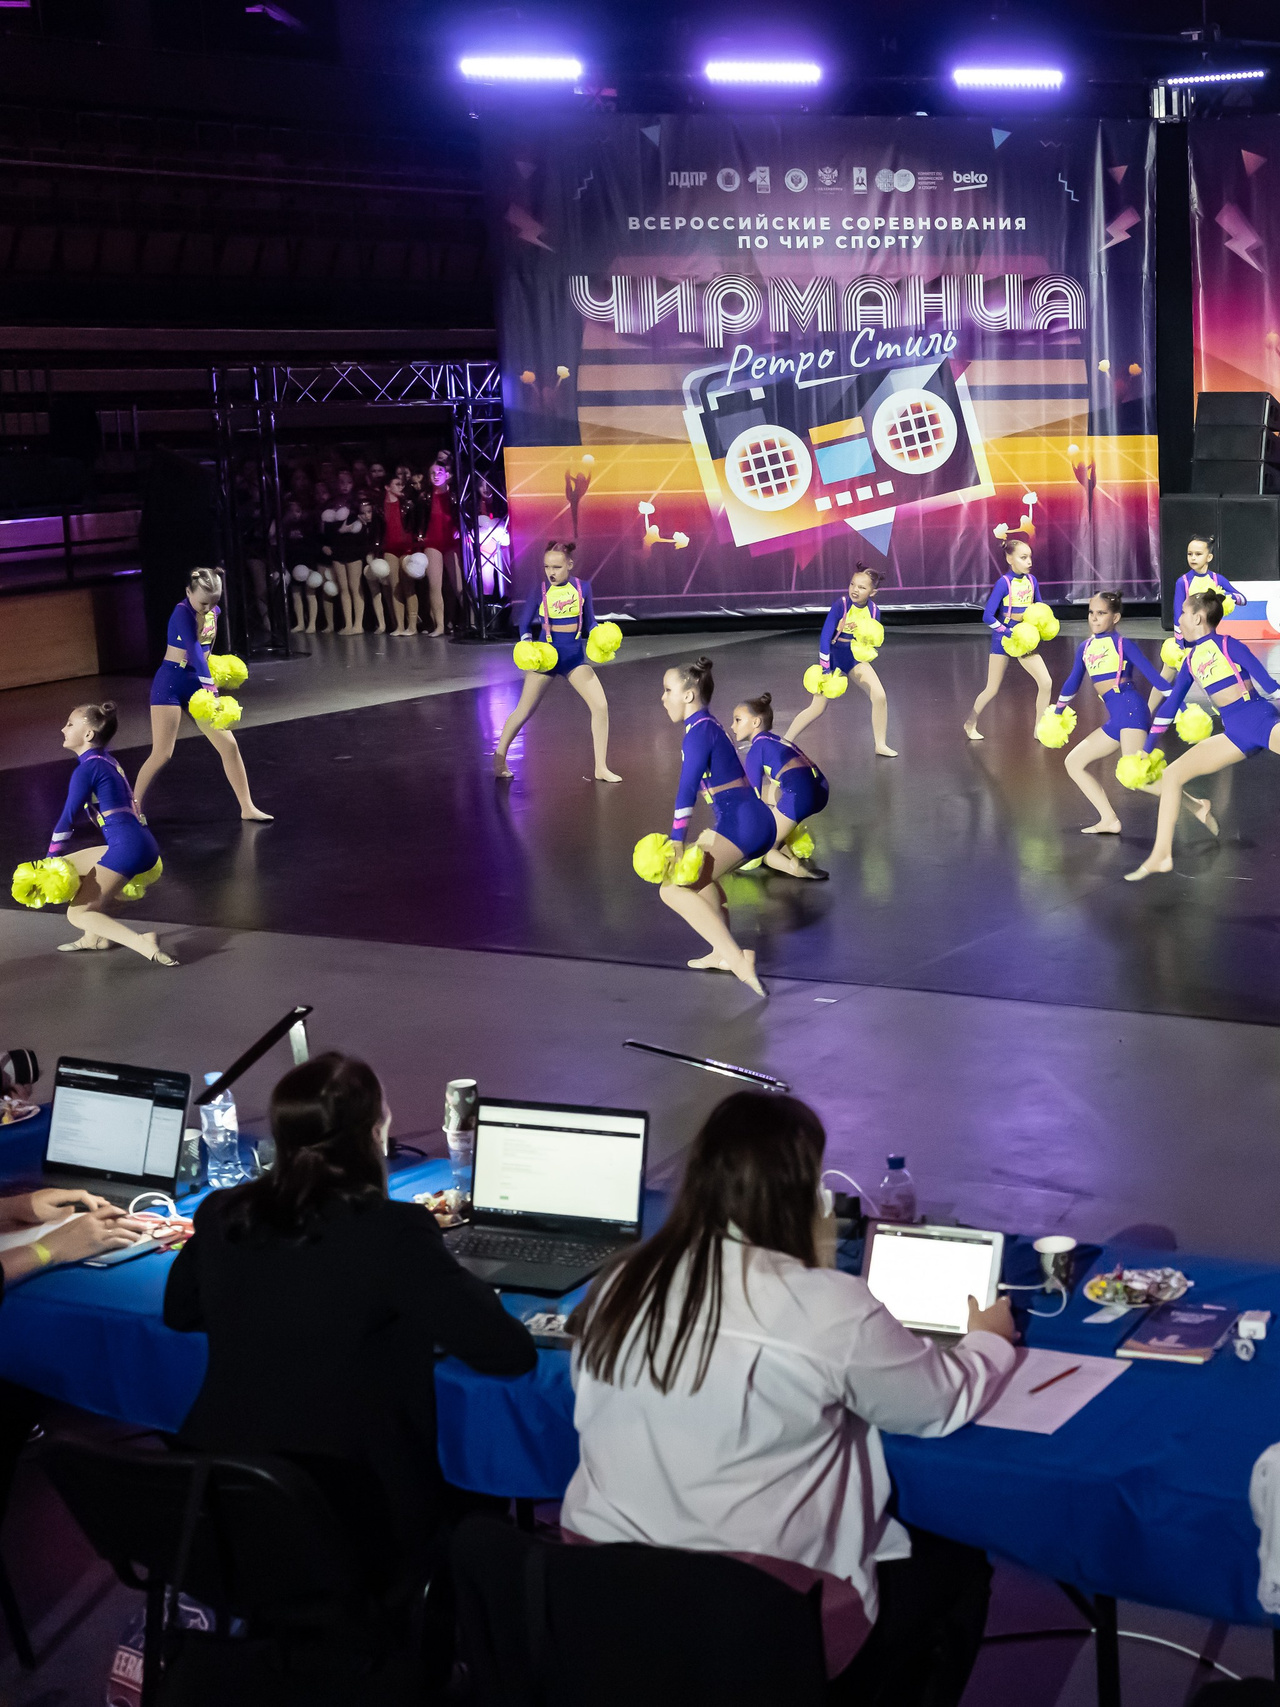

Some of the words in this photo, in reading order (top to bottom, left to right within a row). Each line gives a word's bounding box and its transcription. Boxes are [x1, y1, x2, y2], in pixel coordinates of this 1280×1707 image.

[668, 171, 708, 188] ЛДПР
[953, 170, 989, 184] beko
[628, 214, 831, 230] ВСЕРОССИЙСКИЕ
[842, 217, 1027, 230] СОРЕВНОВАНИЯ
[738, 235, 769, 249] ПО
[779, 235, 825, 249] ЧИР
[835, 235, 924, 249] СПОРТУ
[726, 344, 836, 387] Ретро
[850, 327, 958, 368] Стиль
